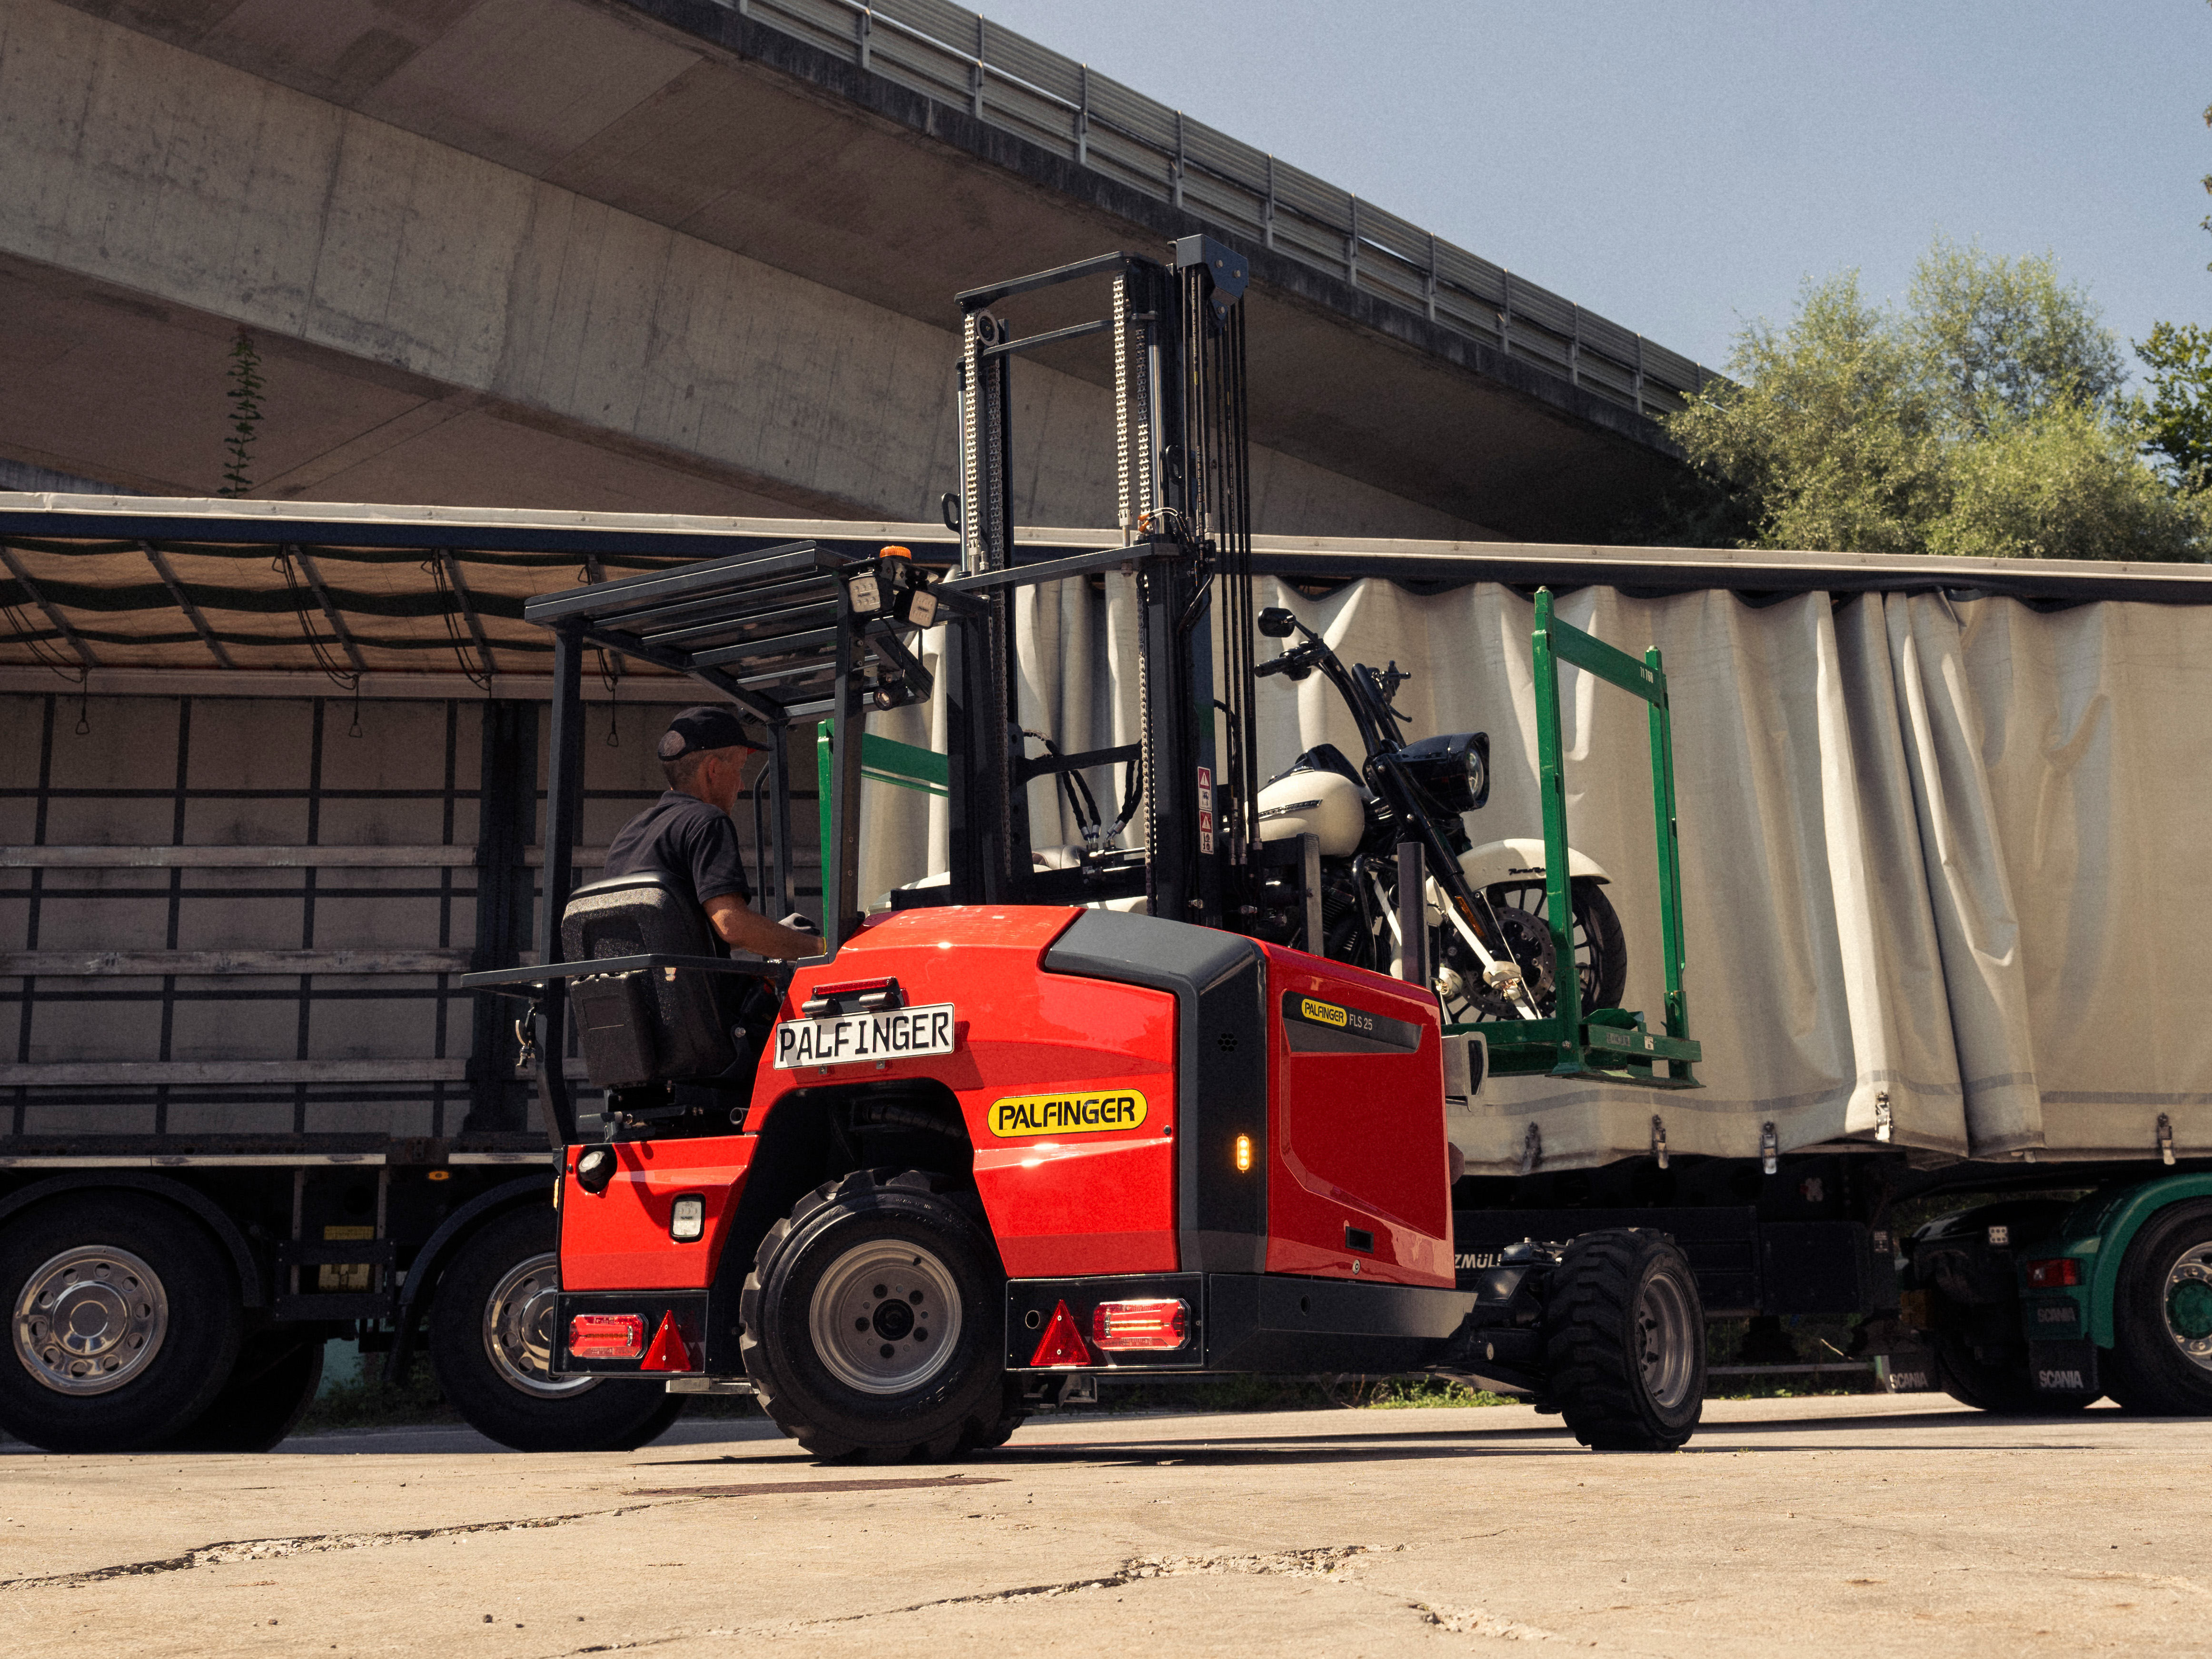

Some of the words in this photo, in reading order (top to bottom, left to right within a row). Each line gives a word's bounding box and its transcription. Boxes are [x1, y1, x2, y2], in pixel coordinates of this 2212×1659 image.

[1305, 1002, 1344, 1023] PALFINGER
[1349, 1014, 1362, 1028] FLS
[1364, 1018, 1372, 1030] 25
[780, 1012, 949, 1062] PALFINGER
[999, 1097, 1135, 1130] PALFINGER
[2037, 1307, 2076, 1323] SCANIA
[1889, 1372, 1929, 1389] SCANIA
[2039, 1370, 2084, 1389] SCANIA
